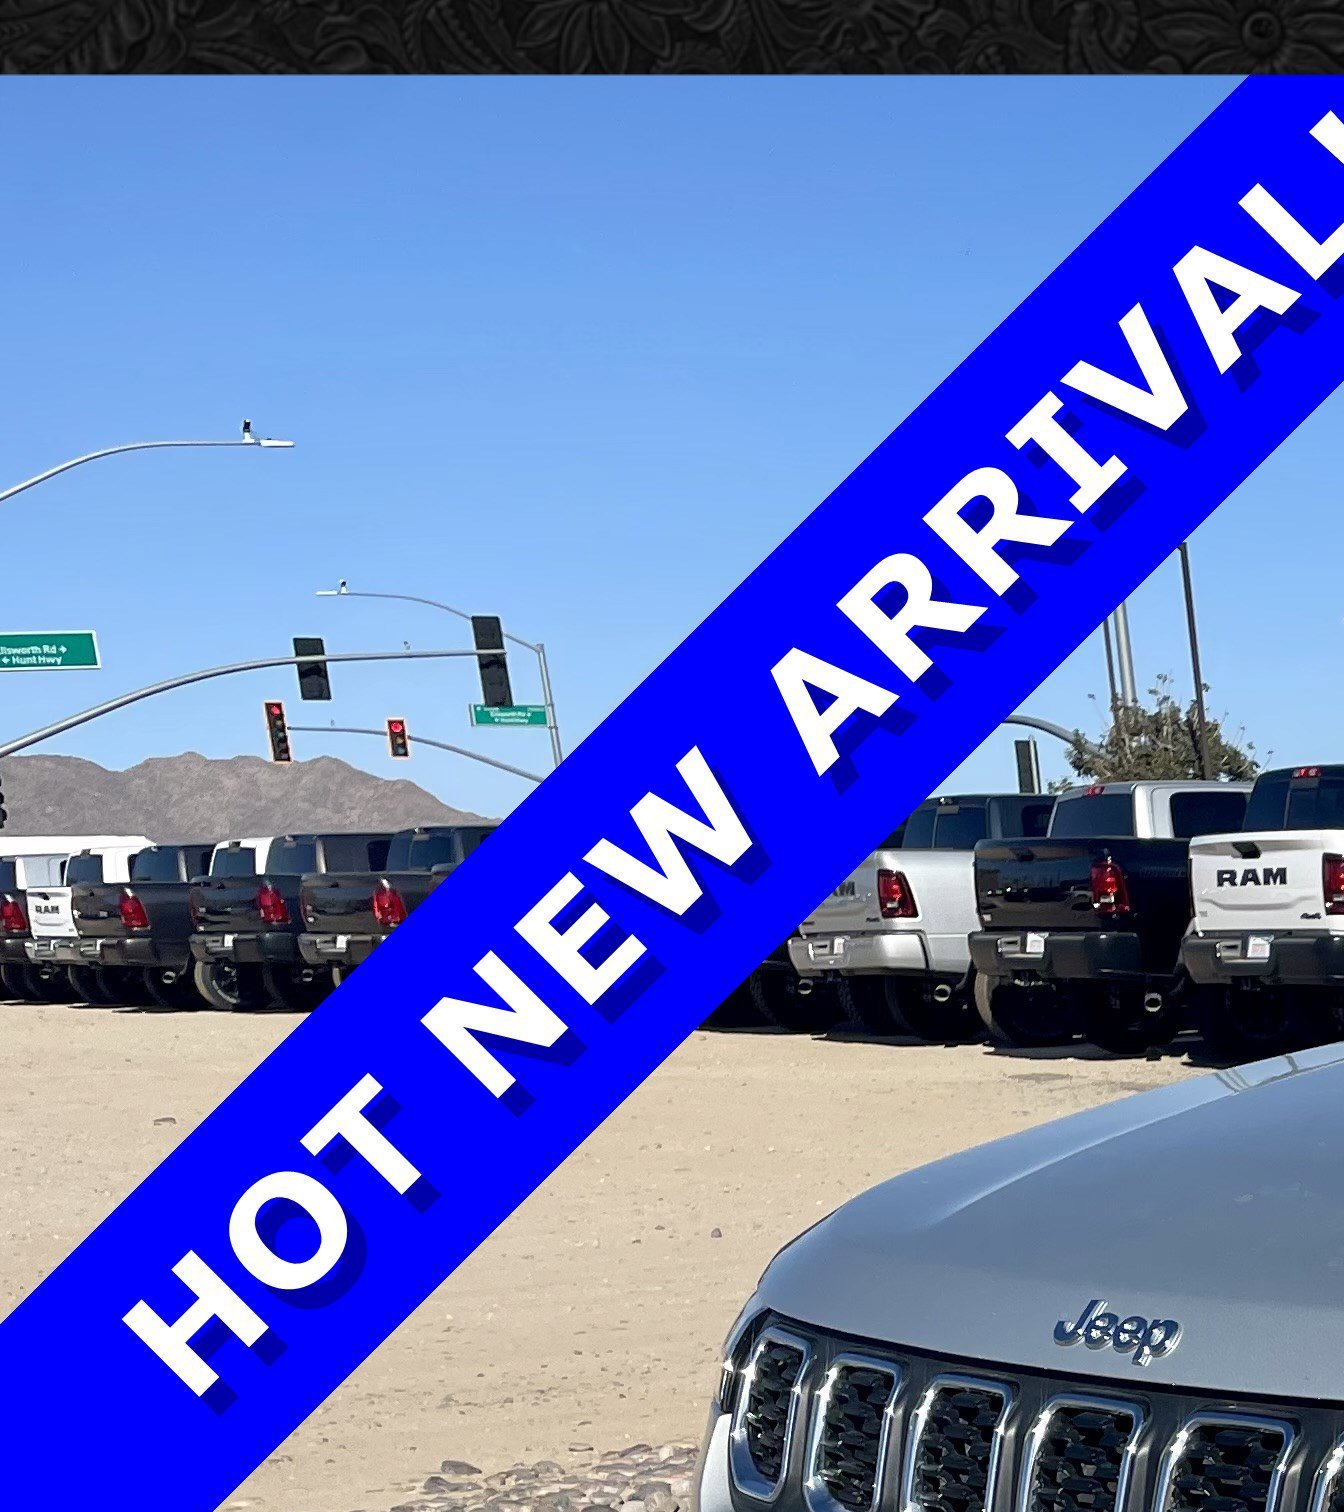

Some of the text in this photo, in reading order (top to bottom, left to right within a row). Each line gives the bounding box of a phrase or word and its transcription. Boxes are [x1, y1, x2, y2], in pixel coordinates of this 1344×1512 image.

[42, 644, 57, 654] Rd
[11, 656, 62, 665] Hunt Hwy
[1216, 867, 1288, 887] RAM
[35, 905, 60, 914] RAM
[1053, 1299, 1182, 1367] Jeep
